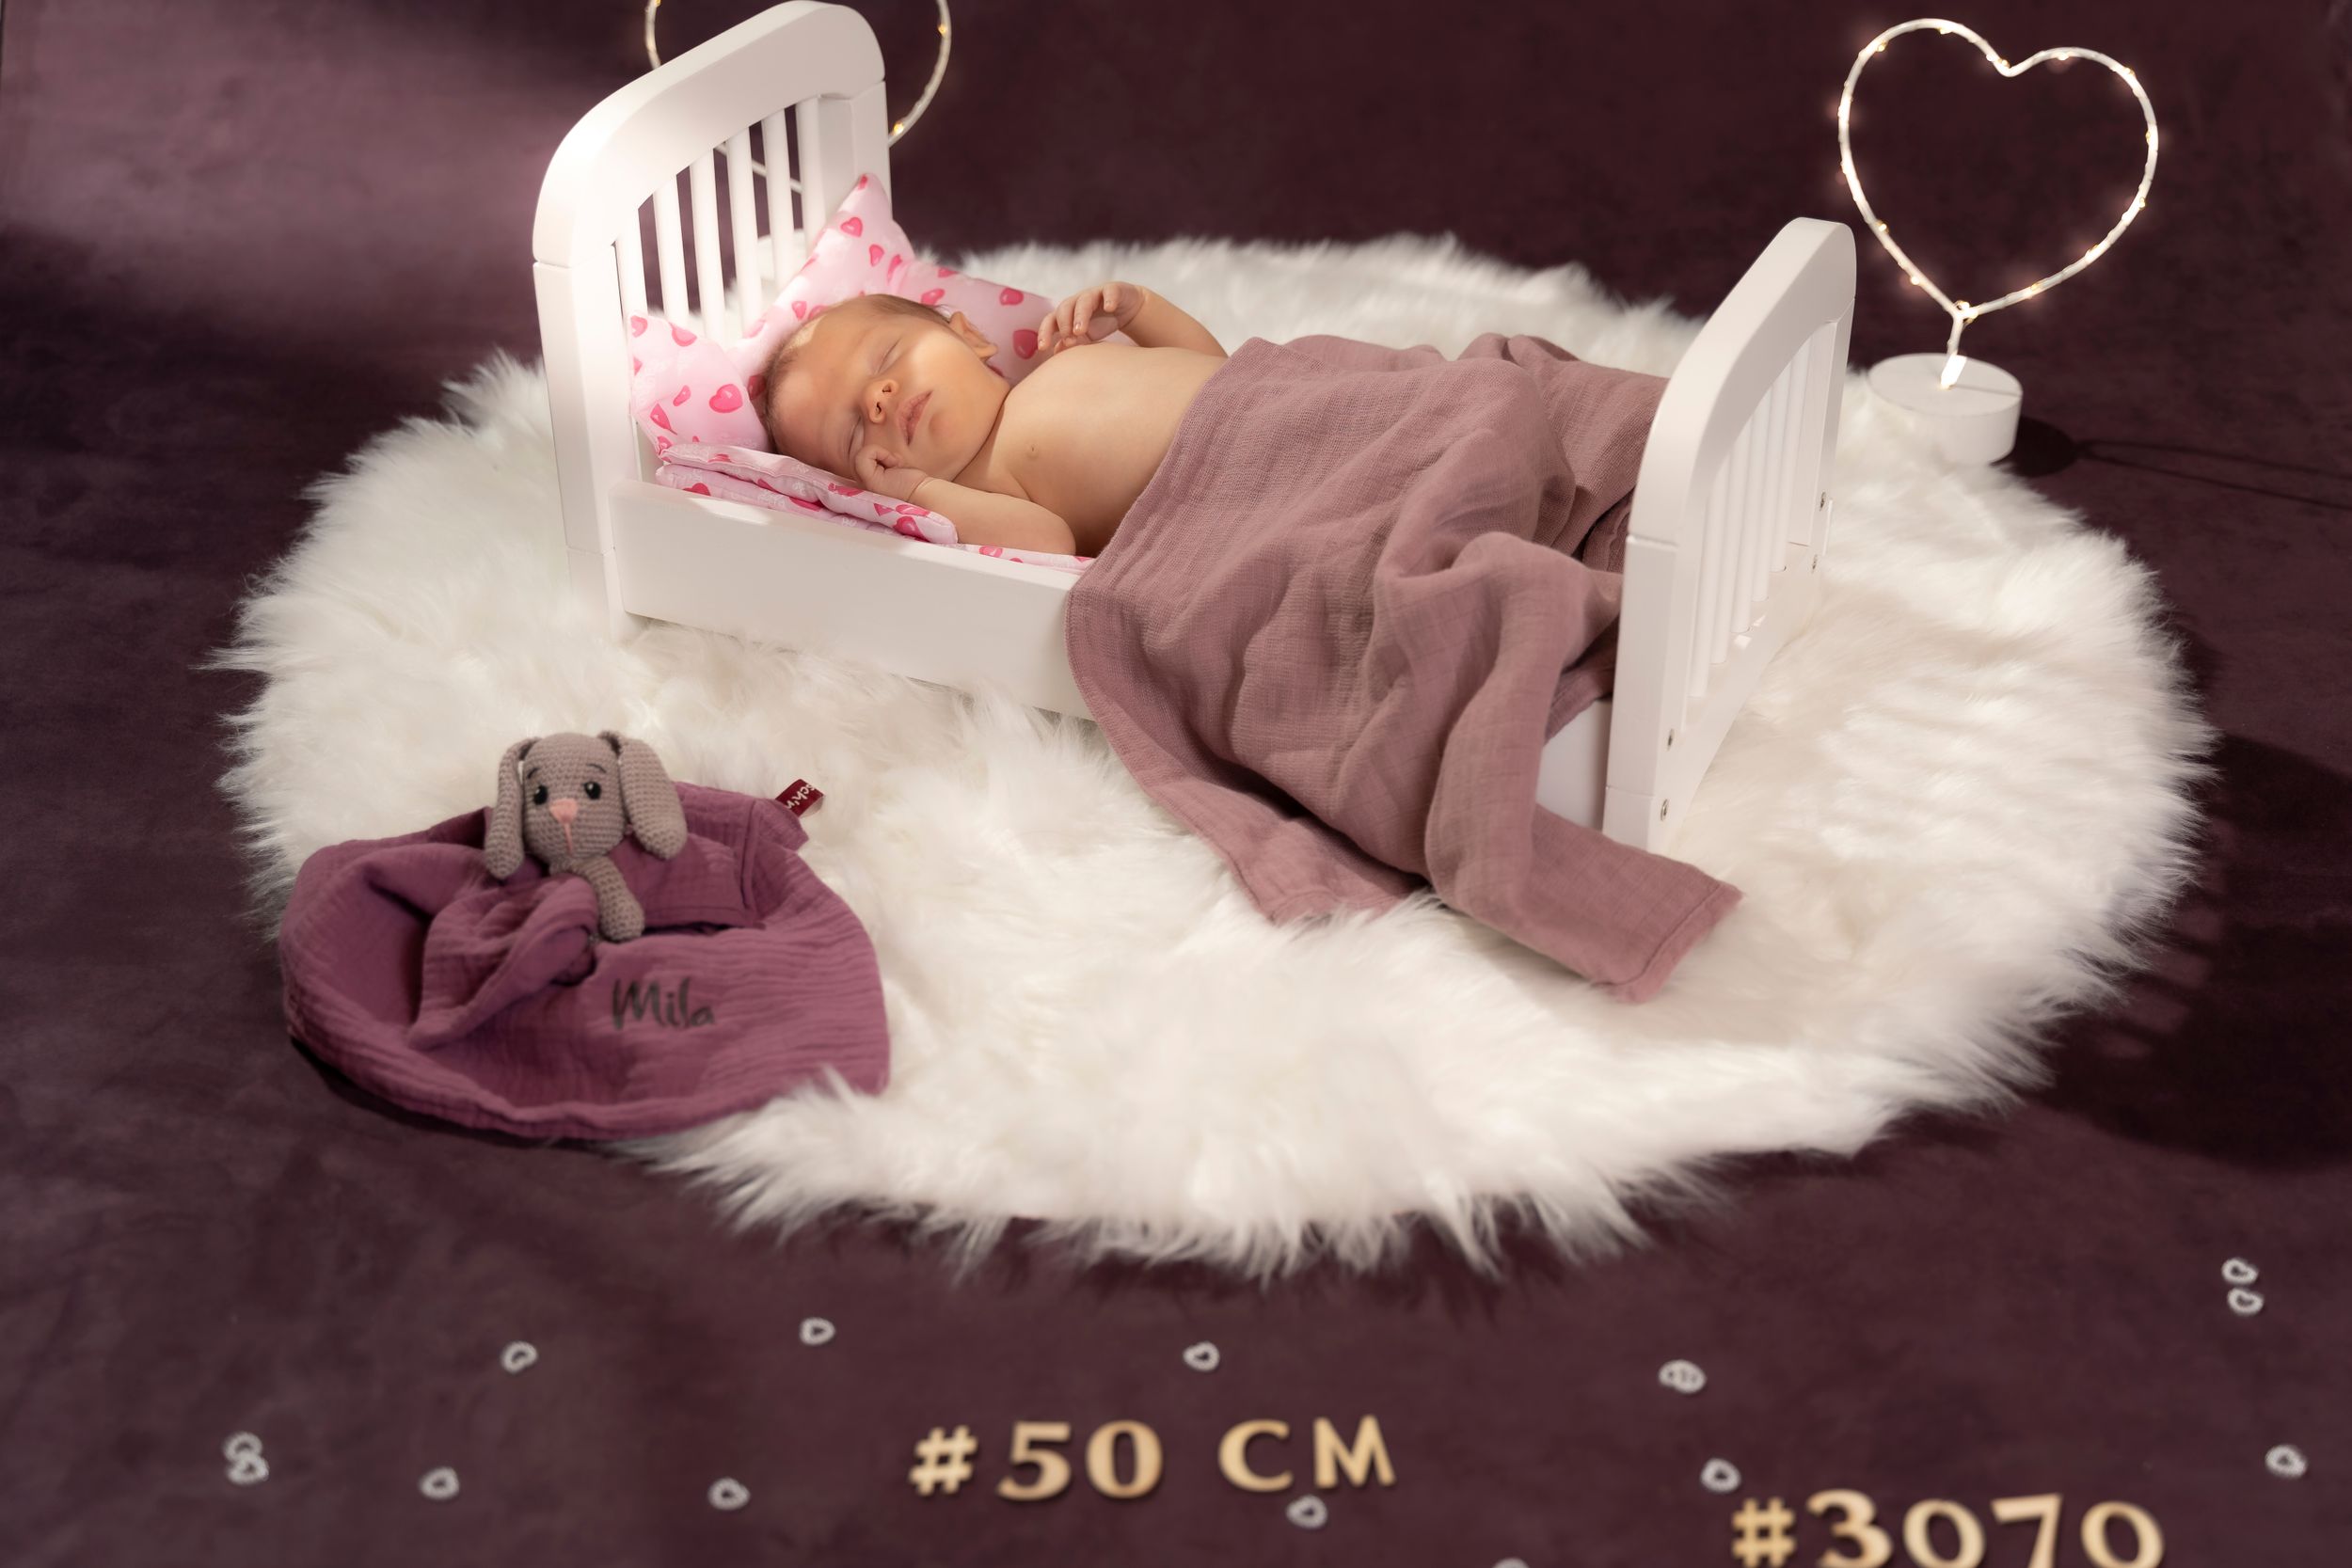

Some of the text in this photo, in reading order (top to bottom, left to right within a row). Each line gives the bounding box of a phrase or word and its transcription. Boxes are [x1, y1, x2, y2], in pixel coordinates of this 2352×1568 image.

[612, 976, 716, 1030] Mila
[908, 1414, 1396, 1501] #50 CM
[1731, 1489, 2165, 1568] #3070
